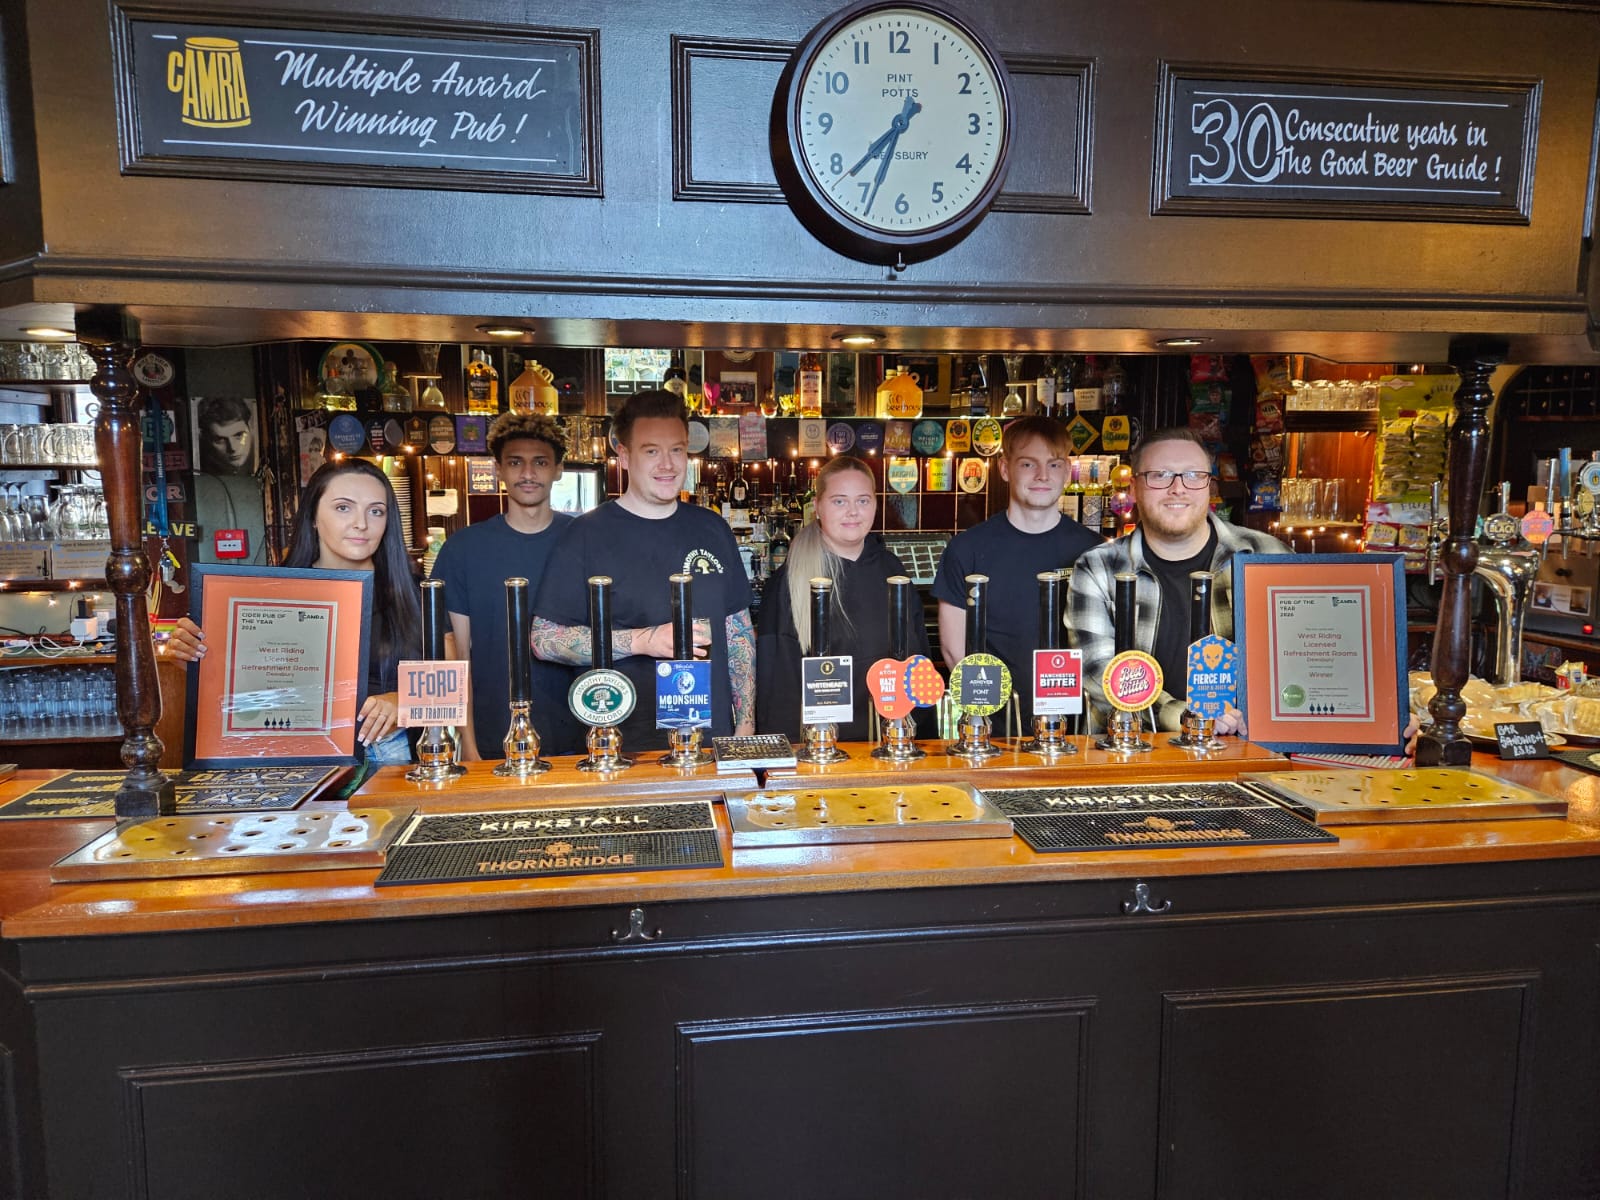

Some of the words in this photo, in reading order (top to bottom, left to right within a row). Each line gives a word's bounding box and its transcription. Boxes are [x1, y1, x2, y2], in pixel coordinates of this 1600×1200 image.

[888, 30, 911, 54] 12
[854, 41, 870, 65] 11
[933, 42, 939, 65] 1
[167, 48, 251, 122] CAMRA
[274, 50, 422, 95] Multiple
[432, 61, 547, 100] Award
[825, 71, 850, 95] 10
[887, 73, 912, 83] PINT
[957, 72, 973, 95] 2
[881, 88, 919, 98] POTTS
[295, 99, 438, 147] Winning
[818, 112, 833, 135] 9
[967, 112, 981, 135] 3
[1284, 109, 1400, 143] Consecutive
[1406, 121, 1458, 150] years
[1466, 121, 1488, 147] in
[1189, 98, 1284, 184] 30
[830, 153, 843, 175] 8
[955, 153, 973, 175] 4
[1277, 146, 1312, 175] The
[1320, 149, 1367, 177] Good
[1373, 152, 1418, 178] Beer
[857, 182, 871, 204] 7
[931, 182, 944, 204] 5
[894, 193, 910, 215] 6
[1297, 632, 1316, 640] West
[1318, 632, 1341, 640] Riding
[264, 655, 299, 663] Licensed
[281, 647, 305, 655] Riding
[241, 664, 291, 672] Refreshment
[1119, 664, 1147, 682] Best
[408, 670, 457, 698] IFORD
[879, 677, 896, 686] HAZY
[880, 684, 896, 693] PALE
[1040, 678, 1077, 688] BITTER
[1193, 673, 1218, 685] FIERCE
[1219, 672, 1232, 684] IPA
[1117, 679, 1150, 699] Bitter
[659, 694, 709, 705] MOONSHINE
[410, 707, 423, 720] NEW
[425, 707, 457, 720] TRADITION
[583, 709, 623, 722] LANDLORD
[1497, 724, 1519, 736] BAR
[1500, 730, 1544, 748] SANDWICH
[1045, 792, 1202, 807] KIRKSTALL
[480, 814, 649, 832] KIRKSTALL
[1104, 827, 1251, 843] THORNBRIDGE
[477, 853, 636, 873] THORNBRIDGE
